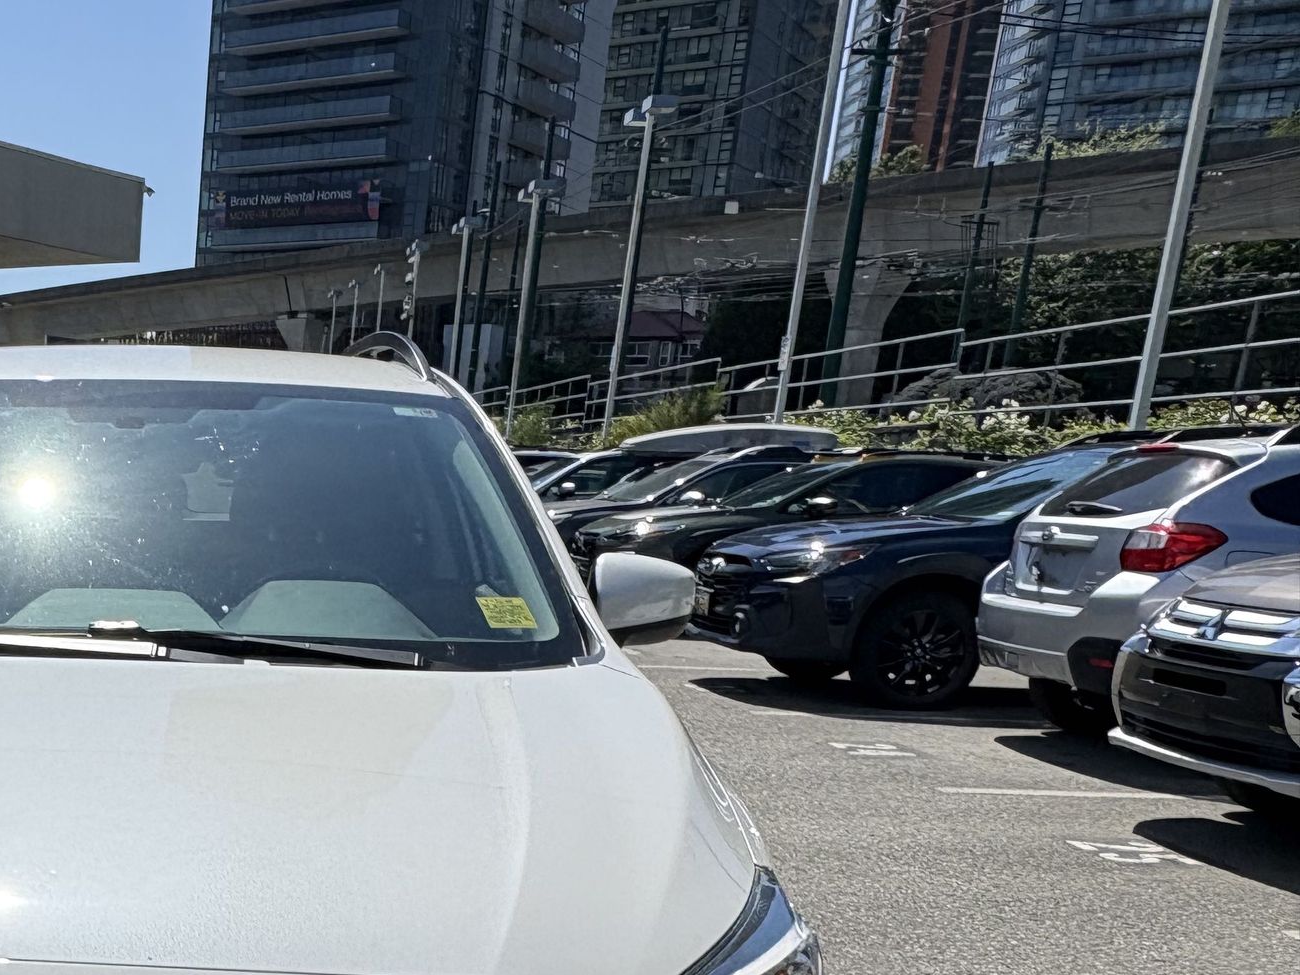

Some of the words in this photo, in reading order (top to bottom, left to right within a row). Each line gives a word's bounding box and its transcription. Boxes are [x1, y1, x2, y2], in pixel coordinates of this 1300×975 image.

[230, 194, 259, 207] Brand
[260, 193, 282, 205] New
[284, 189, 315, 203] Rental
[317, 190, 352, 201] Homes
[271, 207, 300, 218] TODAY
